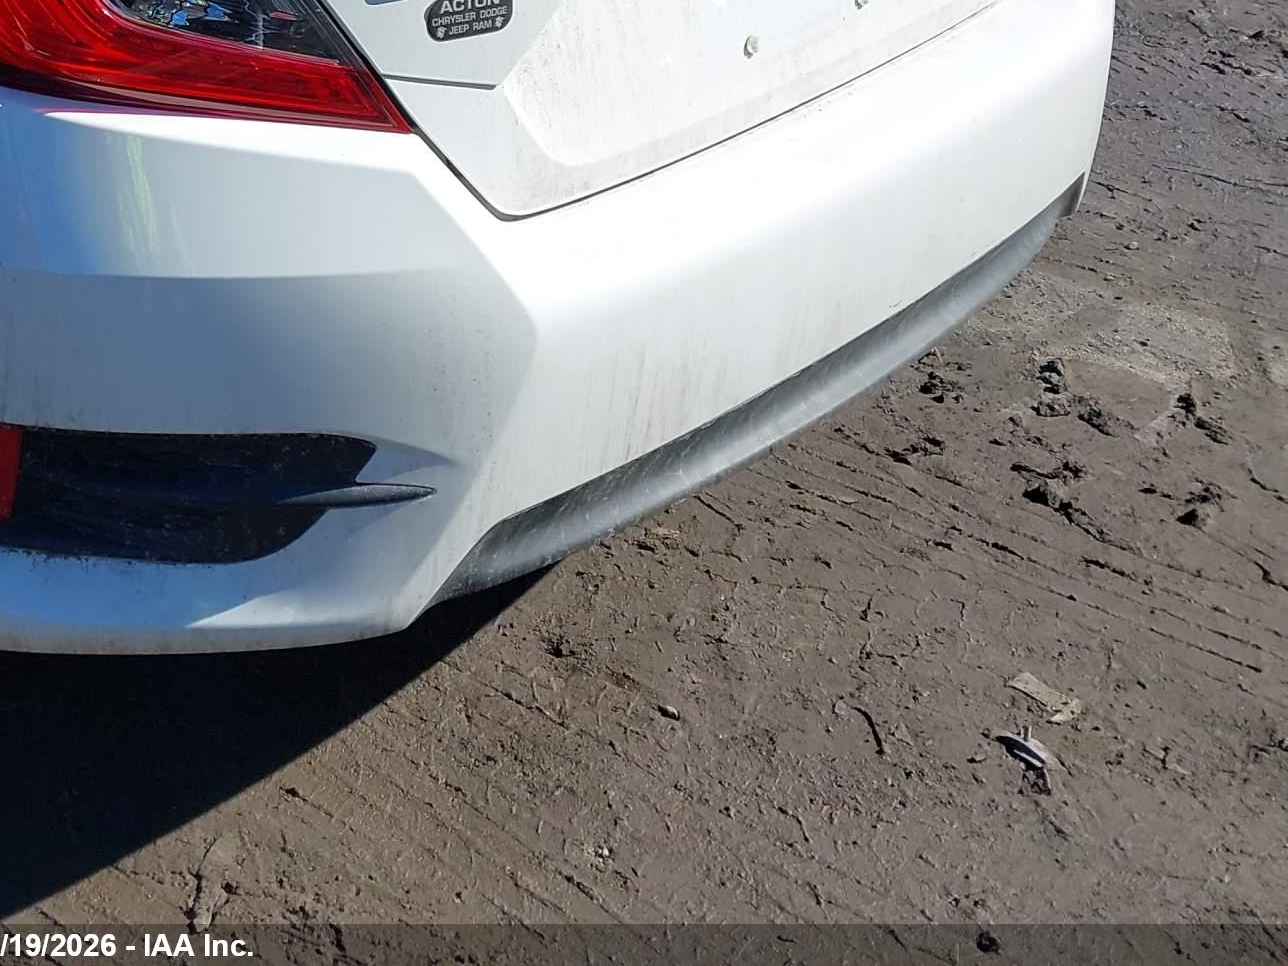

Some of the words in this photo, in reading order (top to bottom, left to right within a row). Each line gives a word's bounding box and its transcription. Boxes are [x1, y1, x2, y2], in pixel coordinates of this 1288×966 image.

[432, 12, 476, 27] CHRYSLER
[479, 5, 509, 18] DODGE
[449, 23, 469, 35] JEEP
[473, 19, 493, 31] RAM
